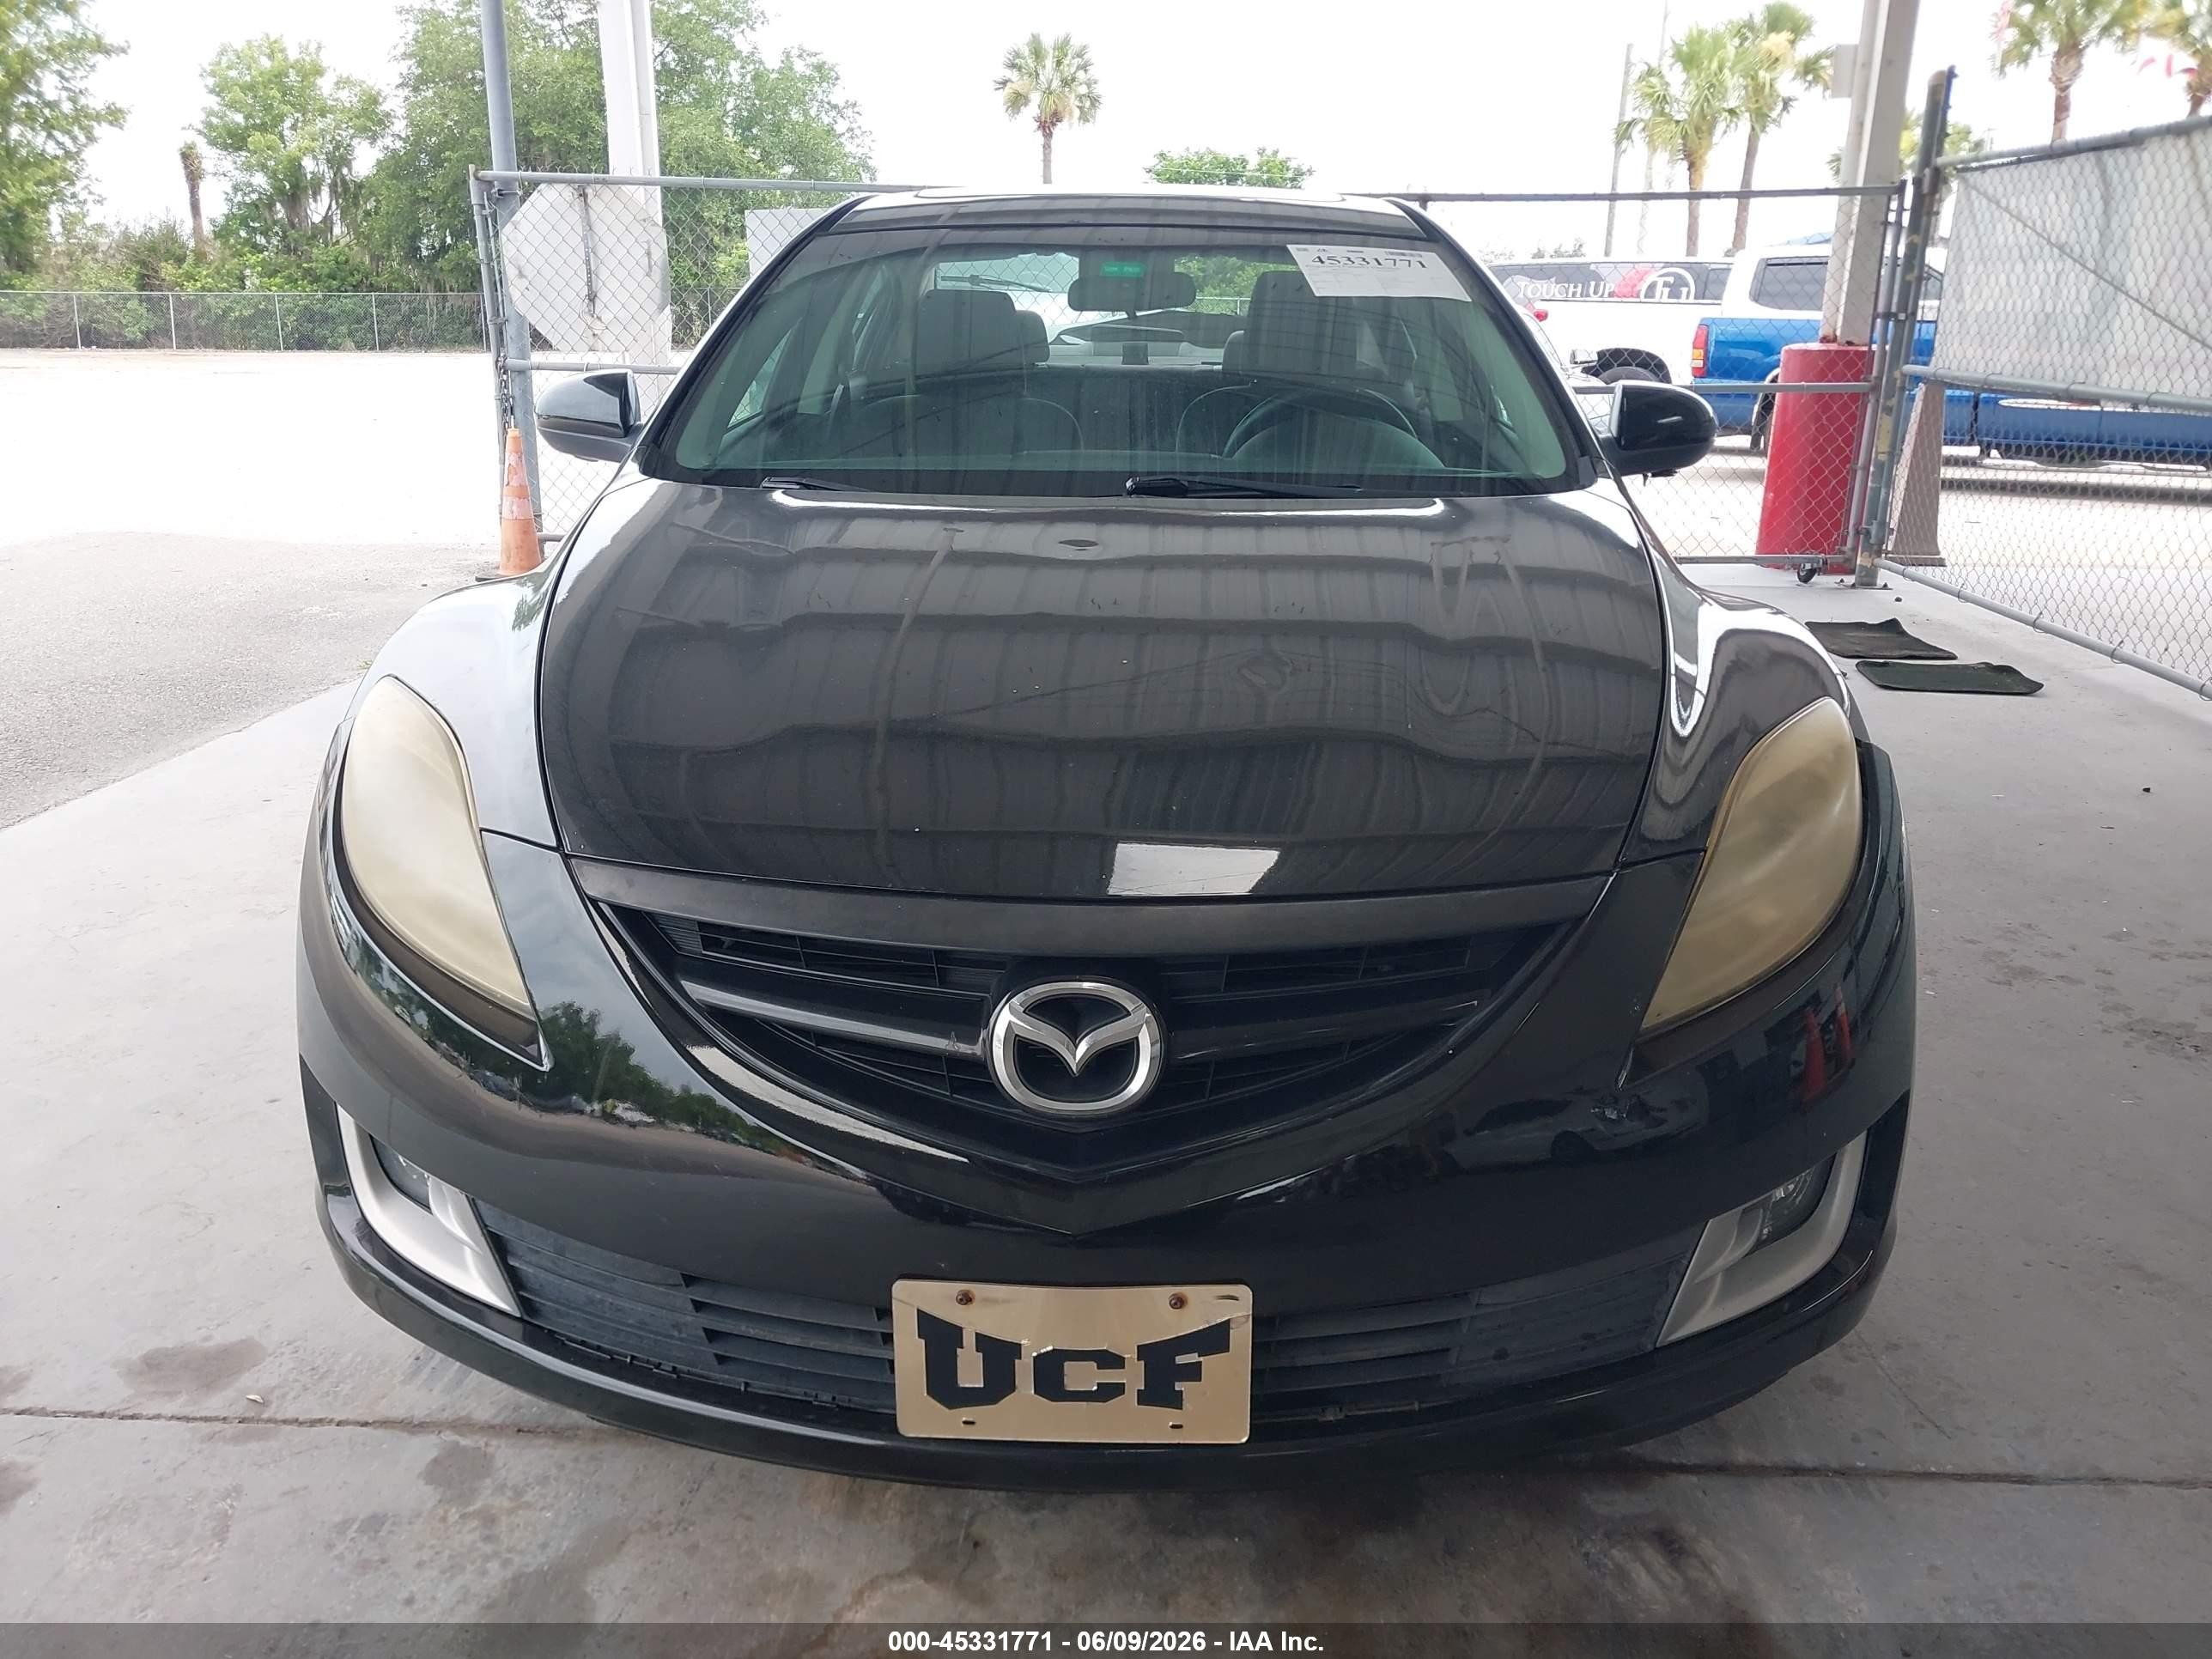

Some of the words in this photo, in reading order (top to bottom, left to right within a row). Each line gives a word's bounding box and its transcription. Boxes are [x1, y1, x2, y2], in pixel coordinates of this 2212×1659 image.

[1312, 255, 1427, 269] 45331771
[1516, 280, 1583, 299] TOUCH
[1589, 281, 1615, 299] UP
[916, 1308, 1231, 1410] UCF
